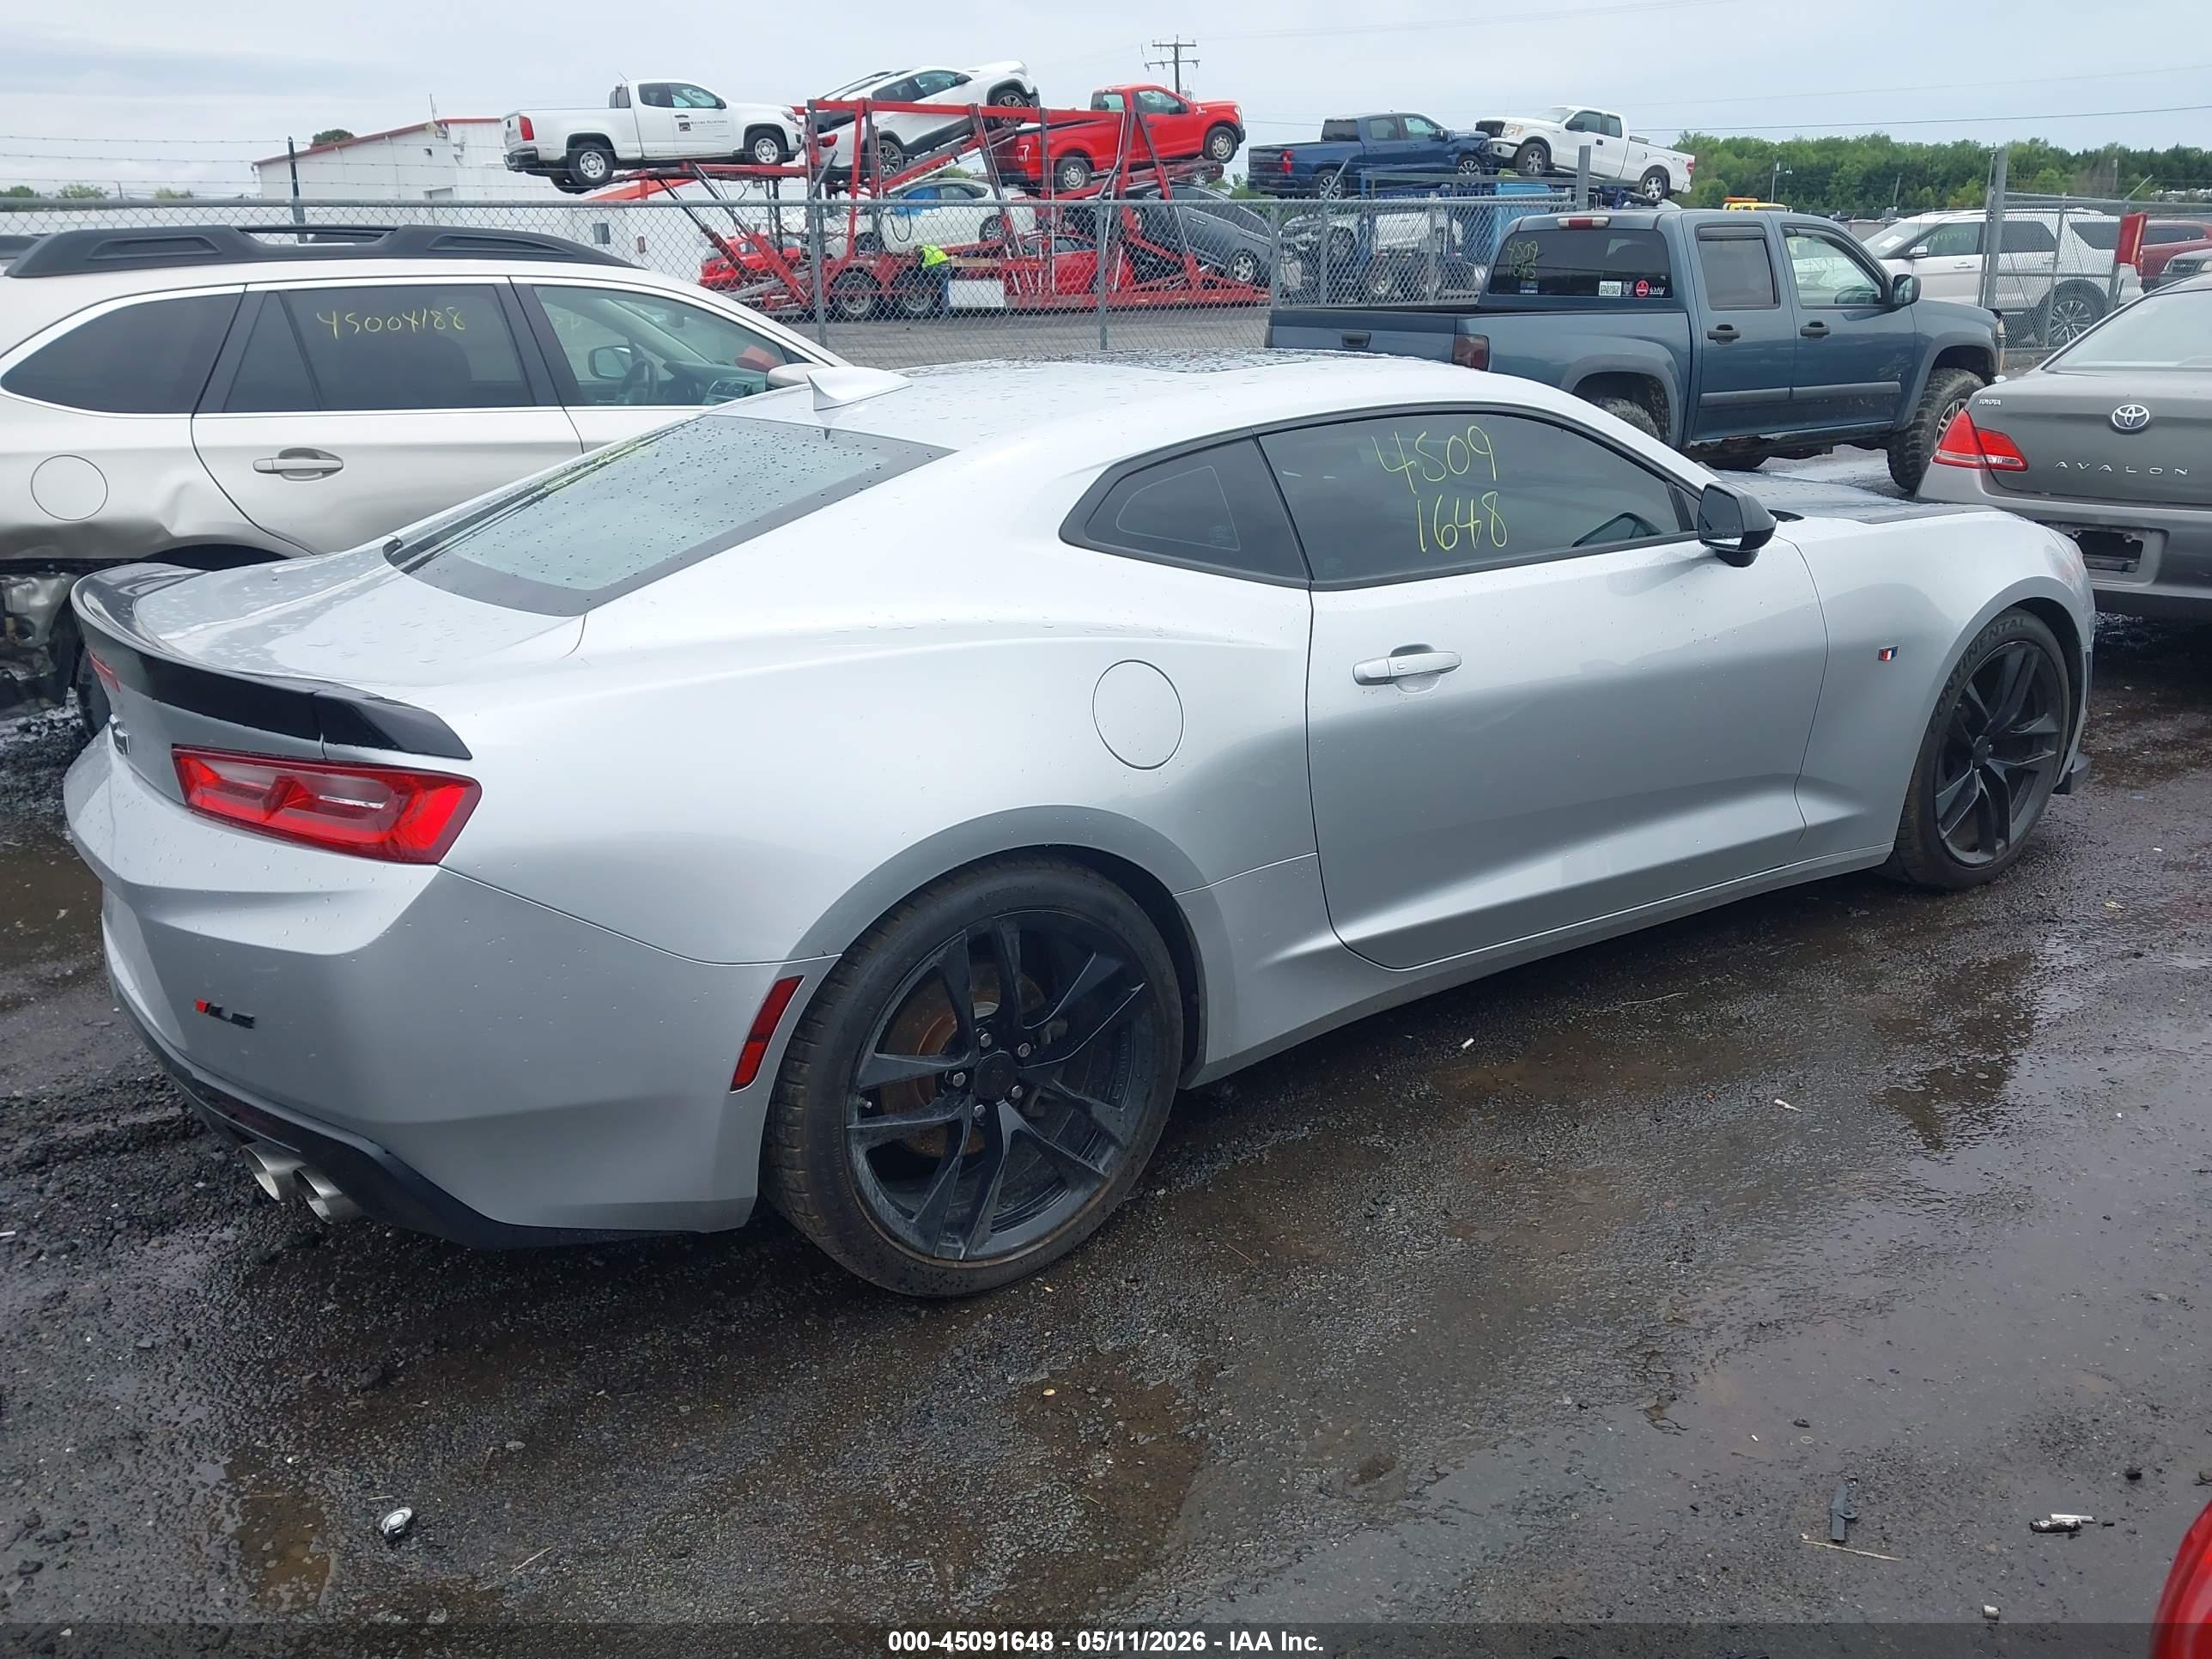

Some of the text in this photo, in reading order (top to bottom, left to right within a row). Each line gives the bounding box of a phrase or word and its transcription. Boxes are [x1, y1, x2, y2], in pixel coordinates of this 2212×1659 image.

[1507, 240, 1538, 262] 4509
[316, 306, 465, 340] 45004188
[1371, 425, 1498, 495] 4509
[2055, 460, 2189, 476] AVALON
[1416, 490, 1509, 552] 1648
